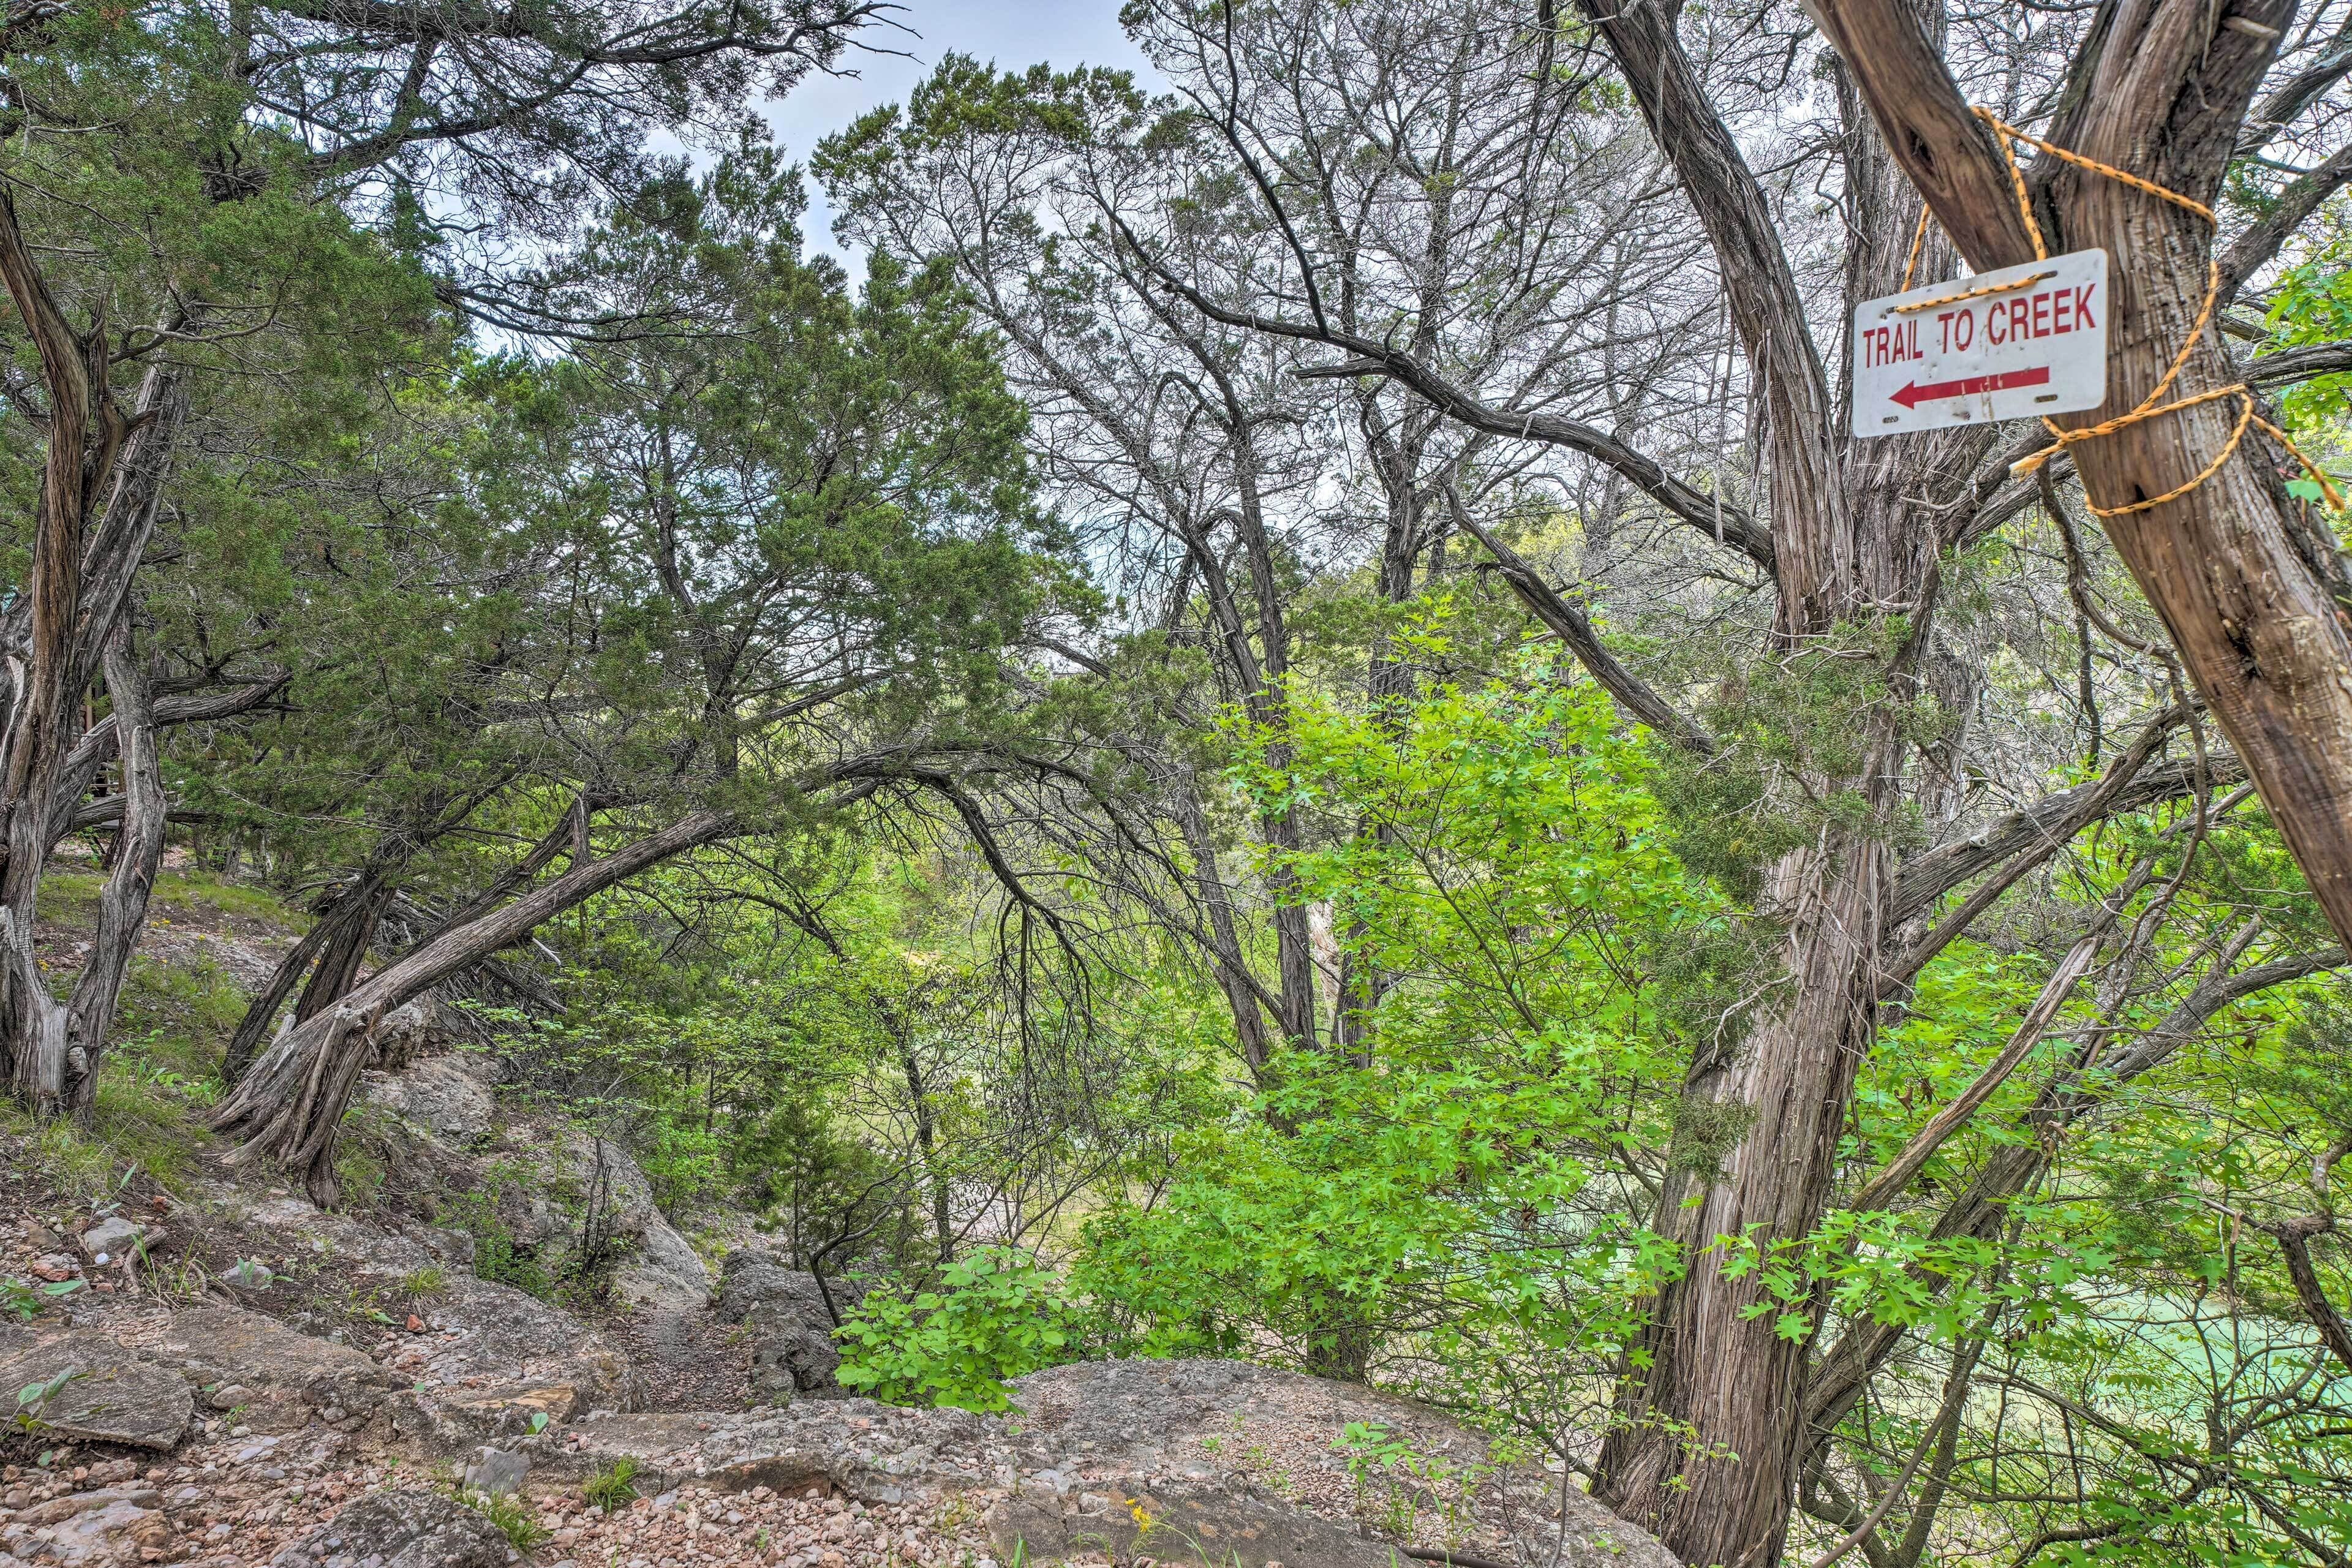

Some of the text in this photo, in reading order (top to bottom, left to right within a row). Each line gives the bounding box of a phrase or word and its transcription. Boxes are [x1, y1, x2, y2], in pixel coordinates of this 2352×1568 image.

[1863, 283, 2096, 368] TRAIL TO CREEK
